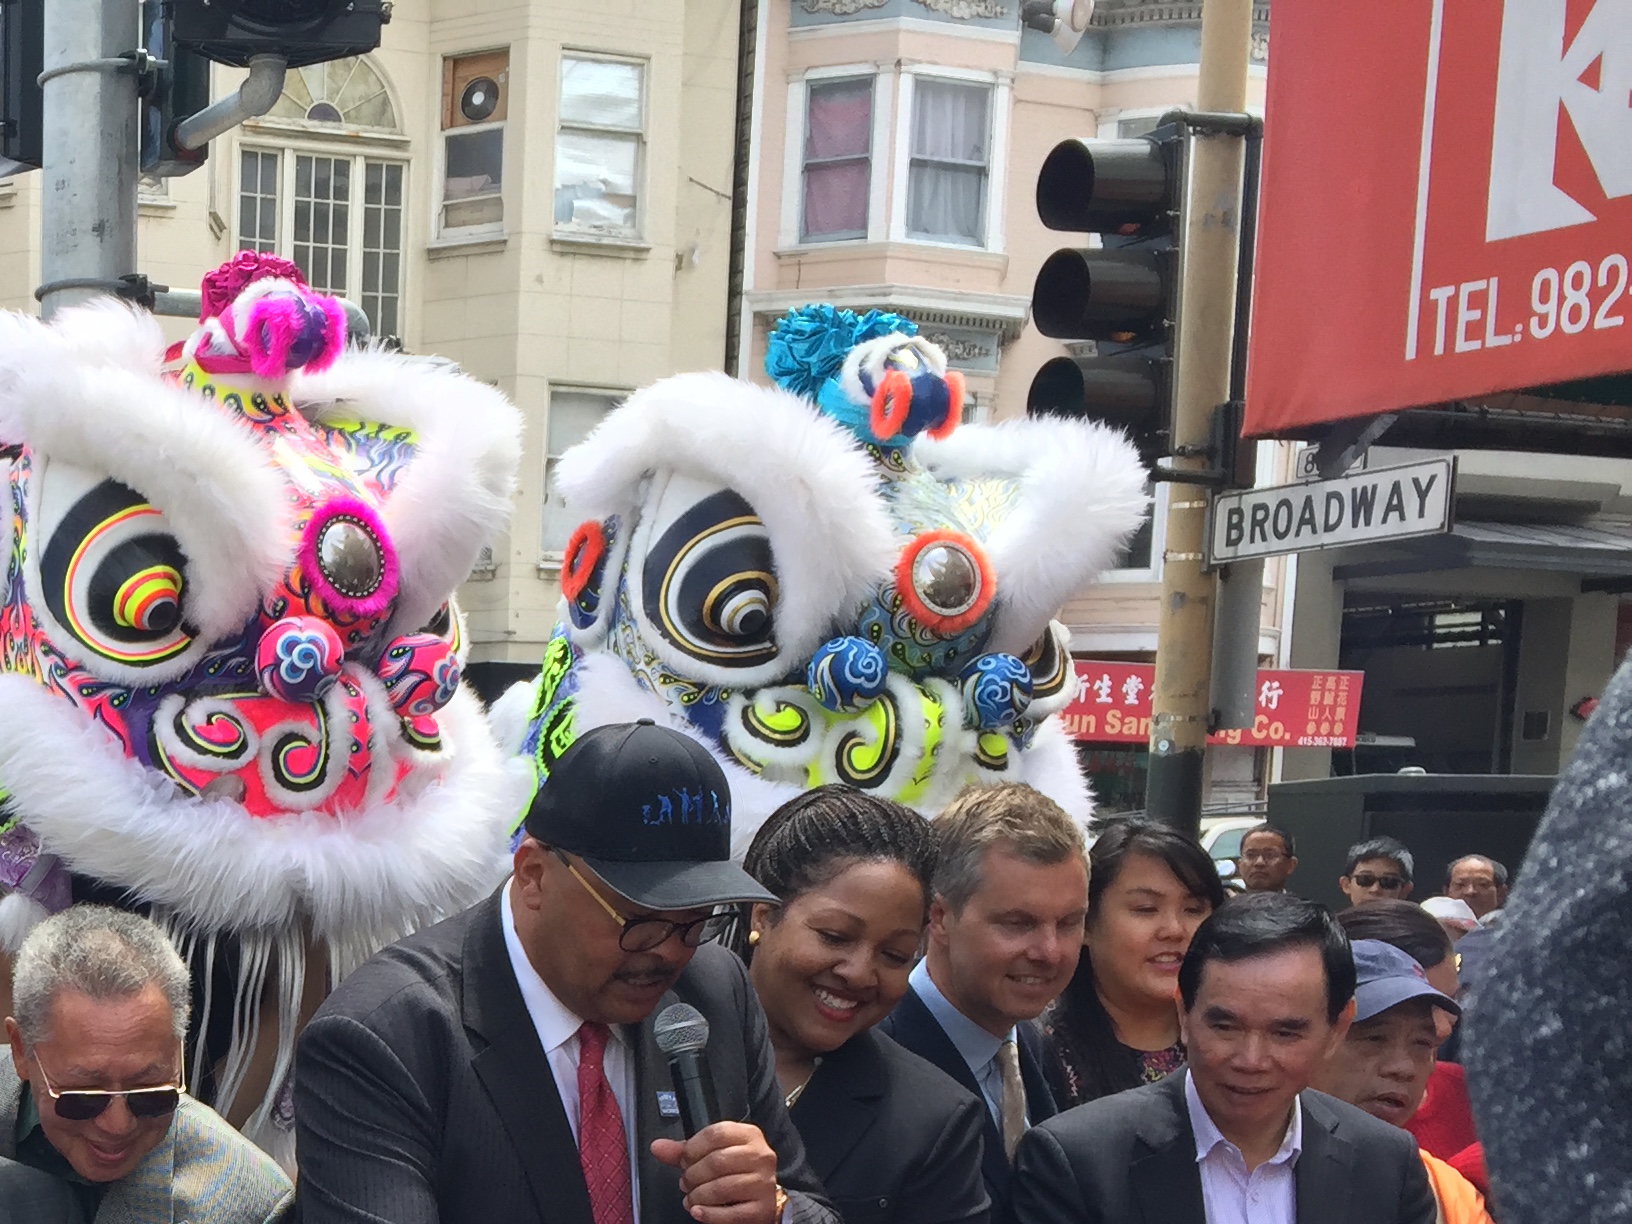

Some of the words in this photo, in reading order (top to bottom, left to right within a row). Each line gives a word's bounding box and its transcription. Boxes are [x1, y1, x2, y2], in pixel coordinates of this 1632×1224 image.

[1225, 473, 1438, 548] BROADWAY
[1059, 712, 1096, 734] un
[1251, 714, 1291, 740] Co.
